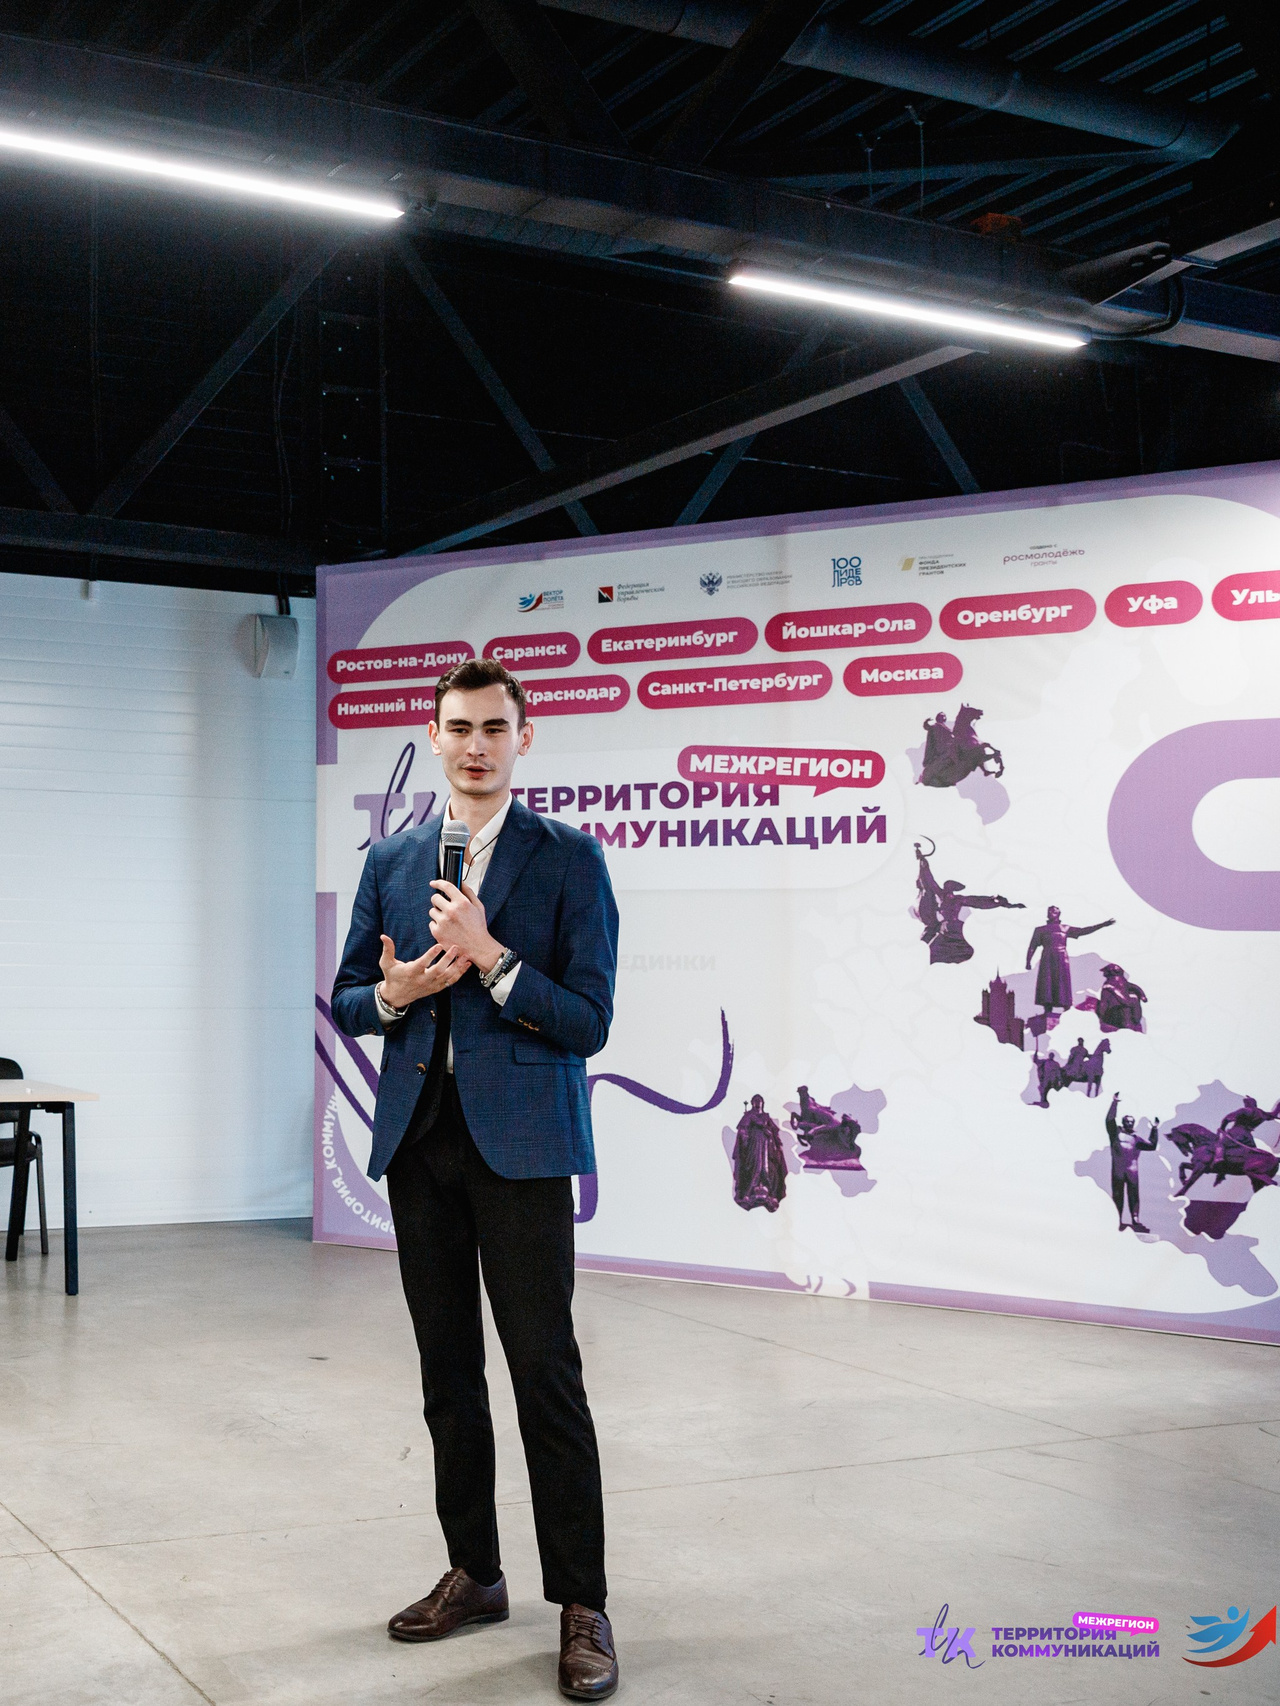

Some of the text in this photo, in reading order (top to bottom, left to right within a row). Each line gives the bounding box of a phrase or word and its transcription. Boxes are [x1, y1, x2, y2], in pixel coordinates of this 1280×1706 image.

[831, 556, 862, 570] 100
[1003, 548, 1085, 565] росмолодёжь
[1127, 593, 1178, 613] Уфа
[1230, 588, 1280, 606] Уль
[957, 602, 1073, 628] Оренбург
[781, 617, 917, 640] Йошкар-Ола
[601, 630, 738, 652] Екатеринбург
[492, 643, 568, 661] Саранск
[336, 652, 468, 673] Ростов-на-Дону
[861, 664, 944, 684] Москва
[648, 673, 823, 697] Санкт-Петербург
[337, 697, 435, 716] Нижний Но
[689, 753, 873, 780] МЕЖРЕГИОН
[580, 805, 887, 850] МУНИКАЦИЙ
